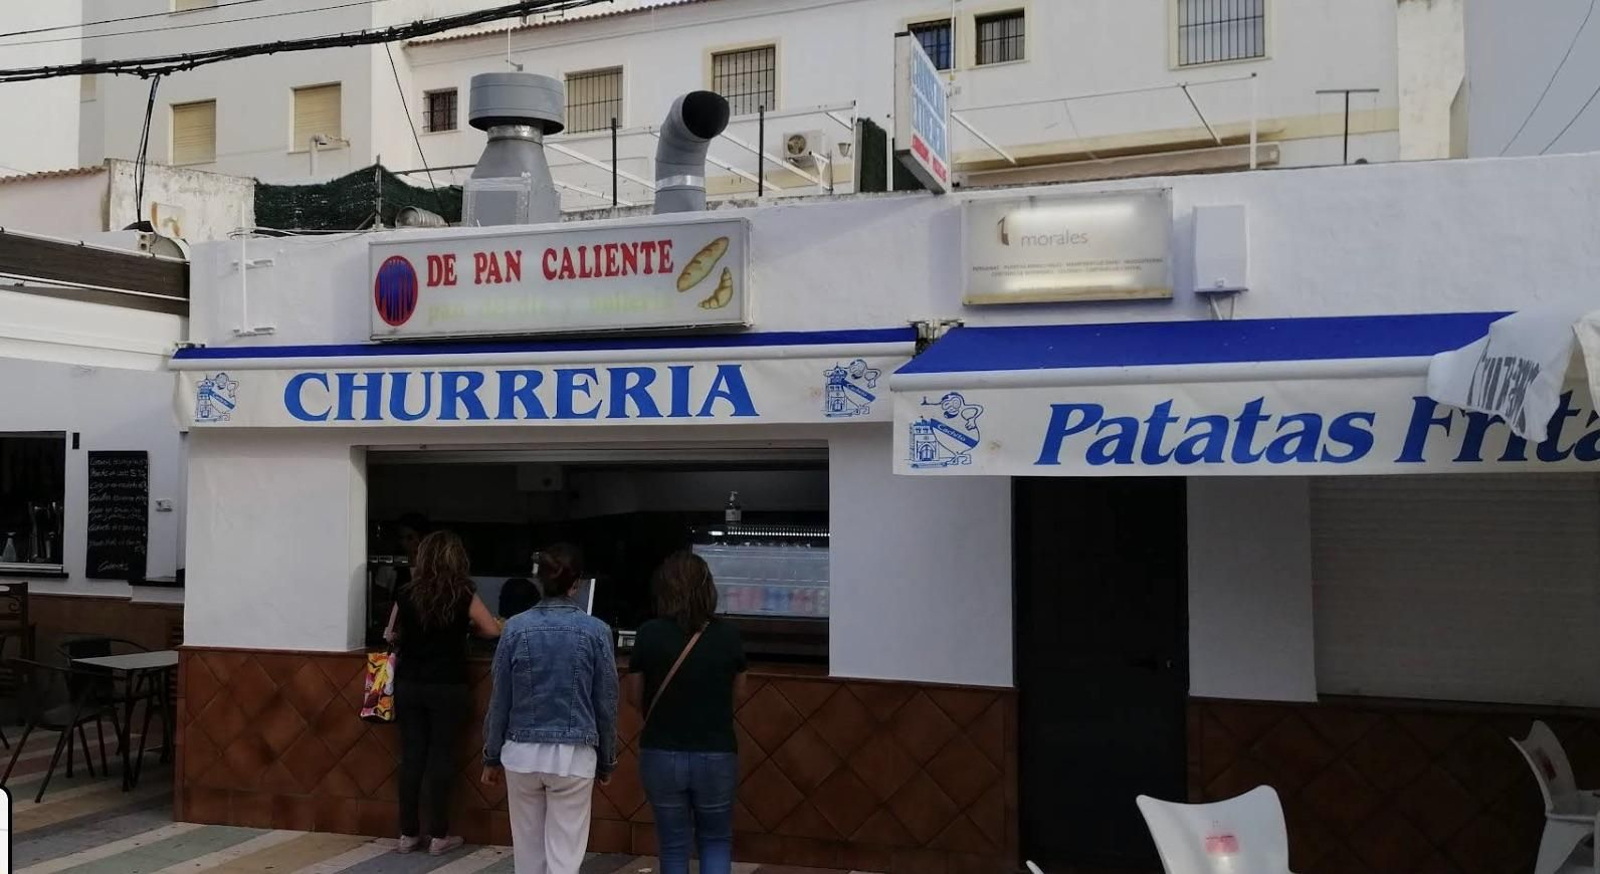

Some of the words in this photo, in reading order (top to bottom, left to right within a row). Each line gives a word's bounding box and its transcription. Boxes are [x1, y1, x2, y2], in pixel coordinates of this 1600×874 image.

[427, 254, 458, 287] DE
[473, 250, 522, 285] PAN
[542, 239, 674, 280] CALIENTE
[1020, 229, 1088, 249] morales
[284, 364, 760, 421] CHURRERIA
[1033, 398, 1376, 467] Patatas
